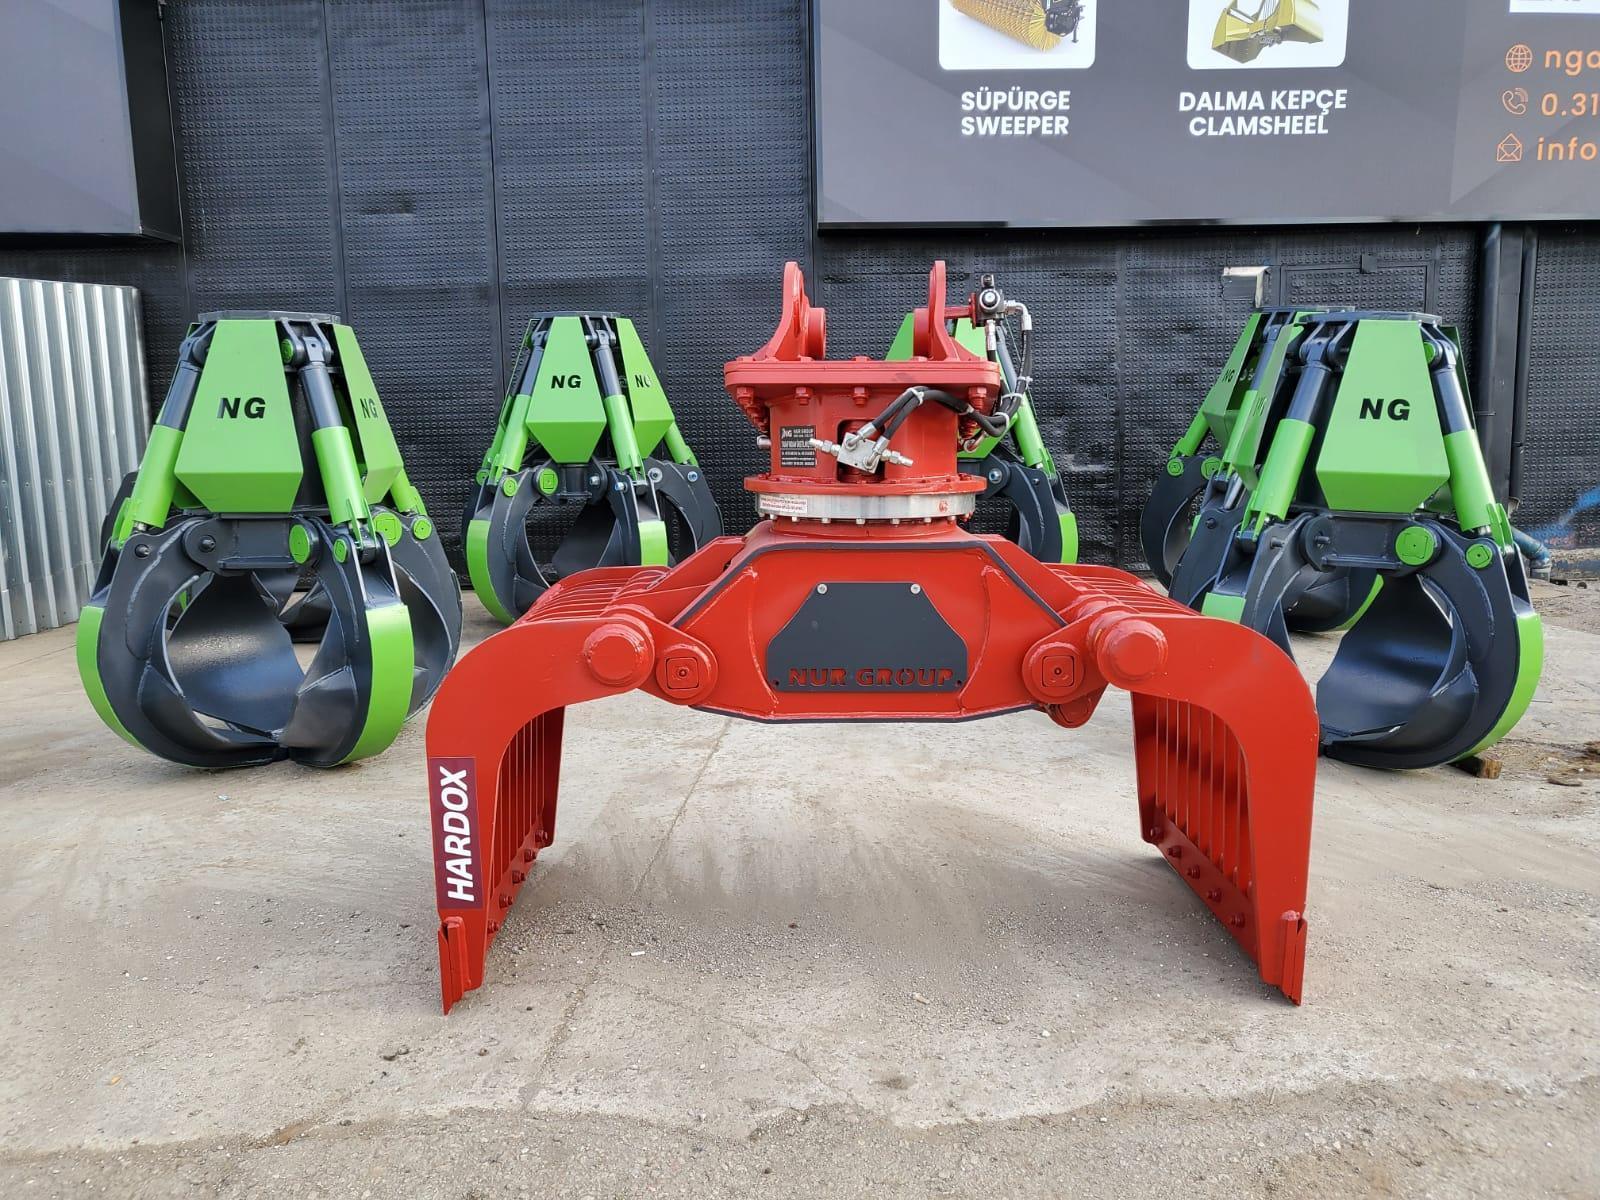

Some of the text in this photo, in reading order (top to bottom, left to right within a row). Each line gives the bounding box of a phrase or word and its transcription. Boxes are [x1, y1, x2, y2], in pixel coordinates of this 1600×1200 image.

[961, 86, 1071, 111] SÜPÜRGE
[1179, 89, 1348, 115] DALMA KEPÇE
[1541, 92, 1600, 116] 0.31
[961, 116, 1069, 136] SWEEPER
[1189, 115, 1329, 136] CLAMSHEEL
[1536, 136, 1598, 161] info
[551, 374, 582, 389] NG
[217, 397, 266, 419] NG
[360, 397, 379, 418] NG
[1359, 398, 1410, 421] NG
[788, 668, 953, 687] NUR GROUP
[439, 765, 475, 902] HARDOX
